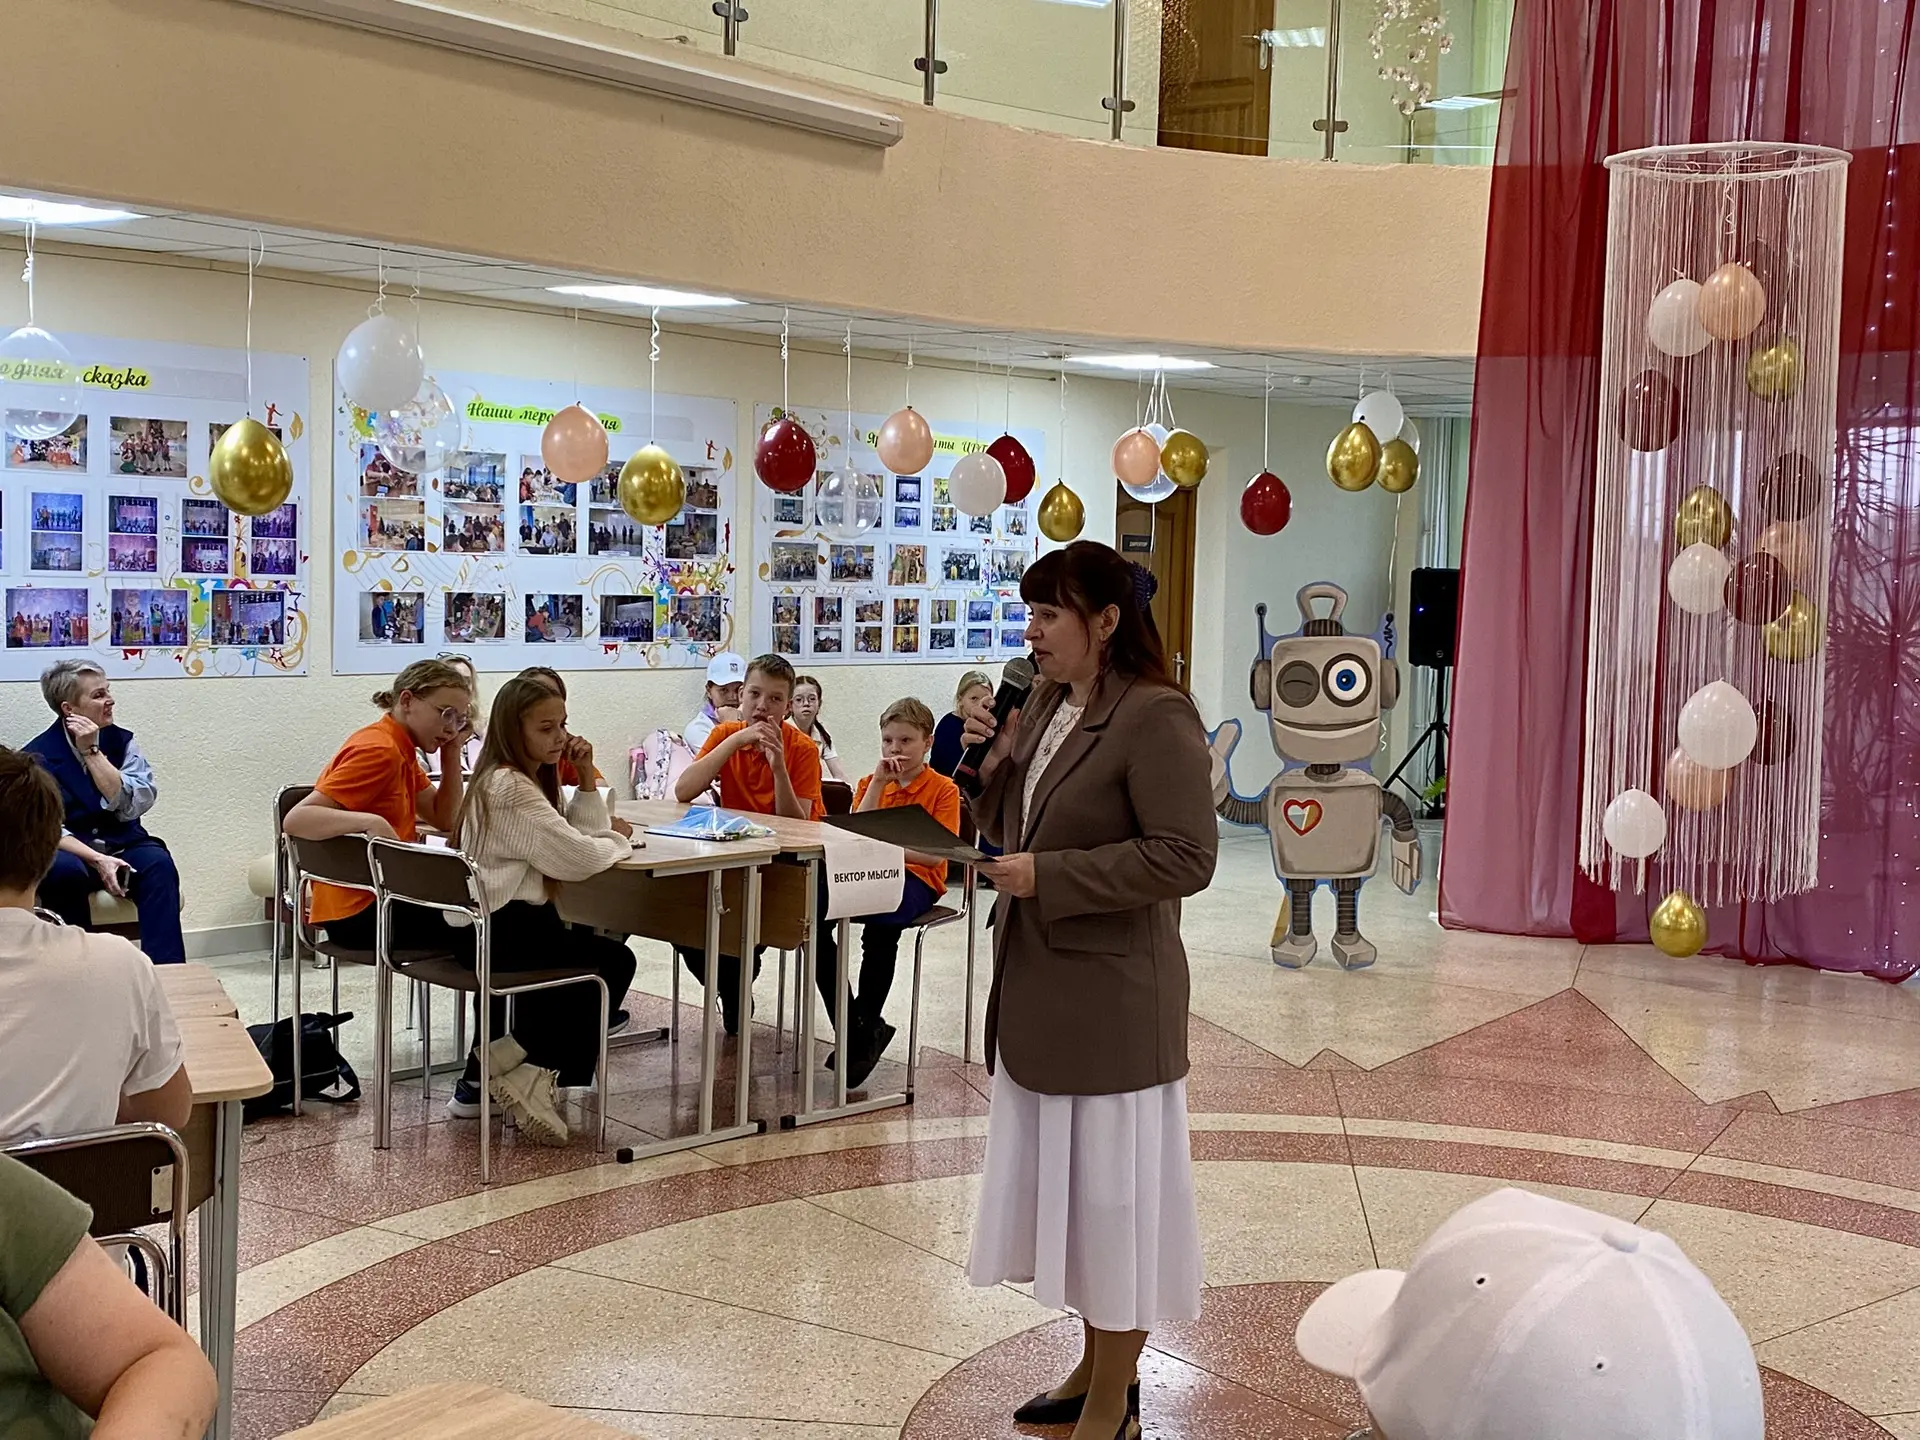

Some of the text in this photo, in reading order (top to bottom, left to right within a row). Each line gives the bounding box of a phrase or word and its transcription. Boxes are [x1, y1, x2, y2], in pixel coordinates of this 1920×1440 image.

[83, 365, 149, 390] сказка
[467, 402, 618, 431] Наши мероия
[834, 868, 900, 883] ВЕКТОР МЫСЛИ
